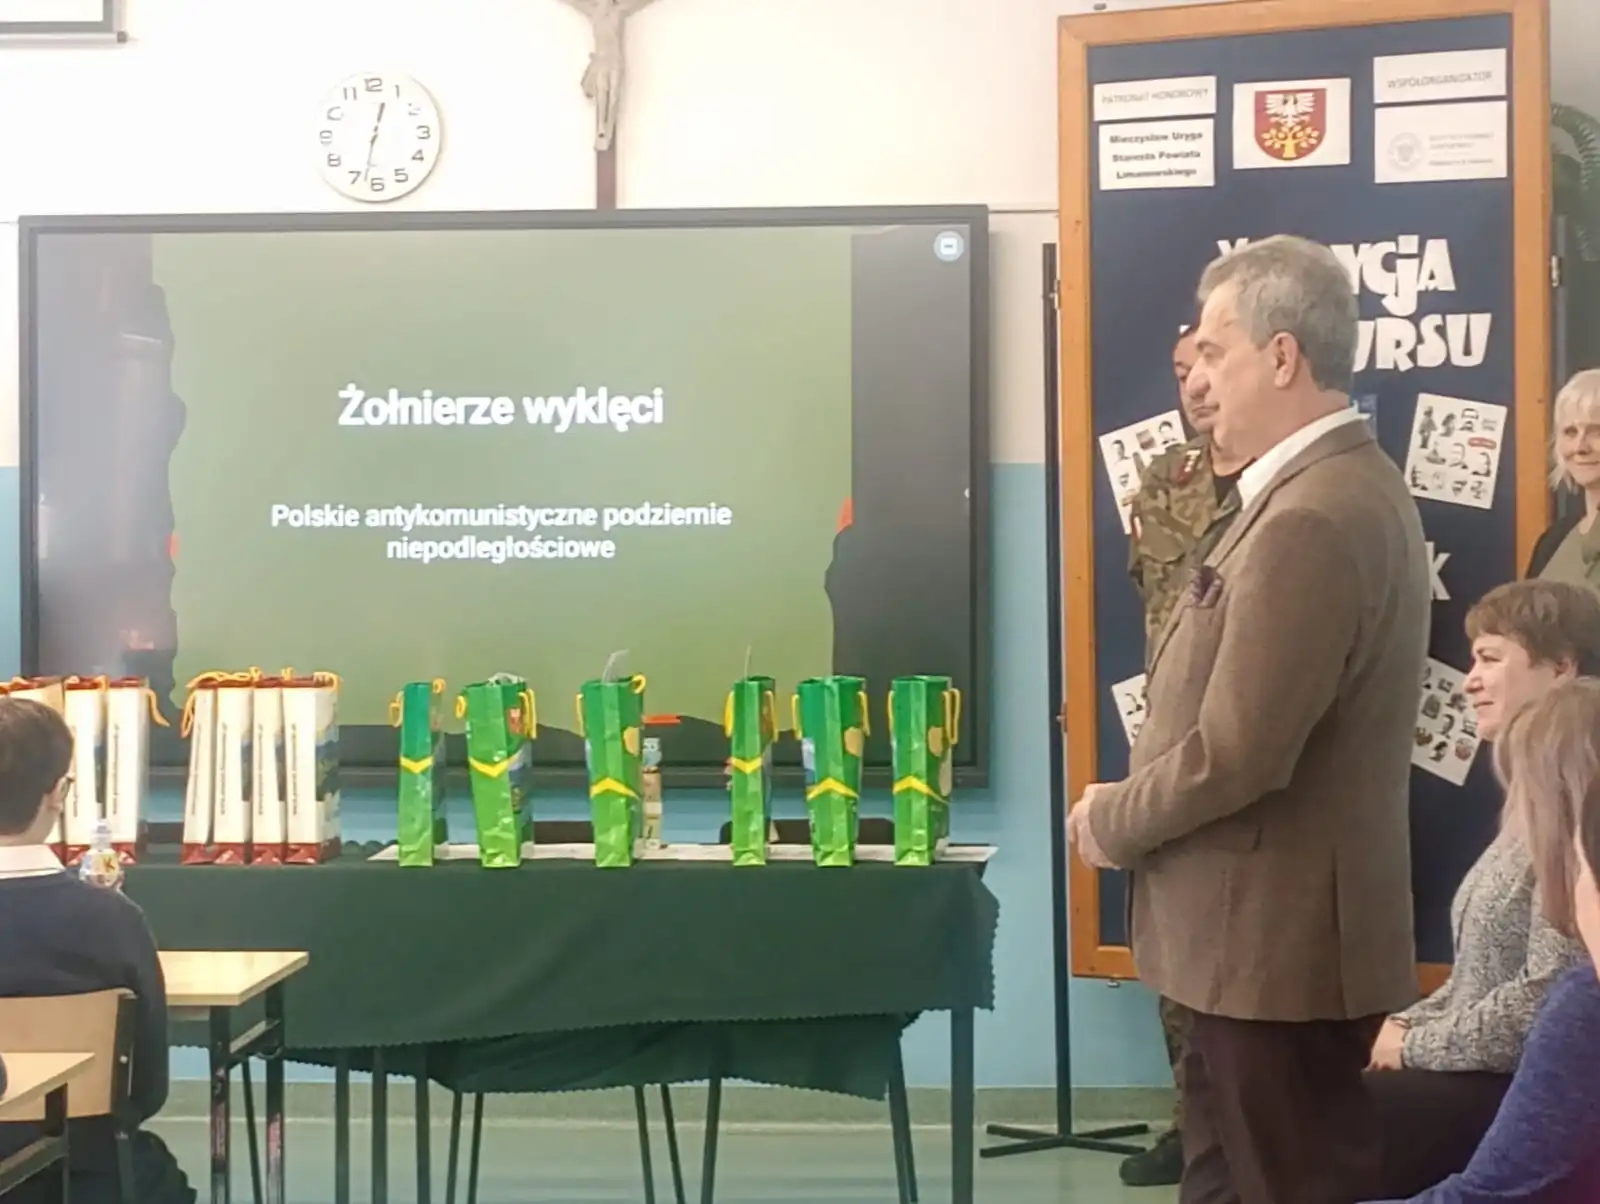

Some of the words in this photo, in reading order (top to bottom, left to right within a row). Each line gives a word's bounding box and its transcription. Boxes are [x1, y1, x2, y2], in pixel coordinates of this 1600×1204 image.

[363, 77, 383, 92] 12
[394, 84, 401, 99] 1
[343, 86, 358, 101] 11
[416, 125, 431, 140] 3
[327, 152, 342, 168] 8
[411, 149, 425, 161] 4
[348, 170, 362, 185] 7
[394, 168, 409, 183] 5
[370, 177, 385, 192] 6
[338, 382, 514, 427] Żołnierze
[523, 386, 664, 433] wyklęci
[271, 503, 360, 528] Polskie
[365, 503, 598, 532] antykomunistyczne
[603, 501, 732, 531] podziemie
[386, 529, 616, 564] niepodległościowe
